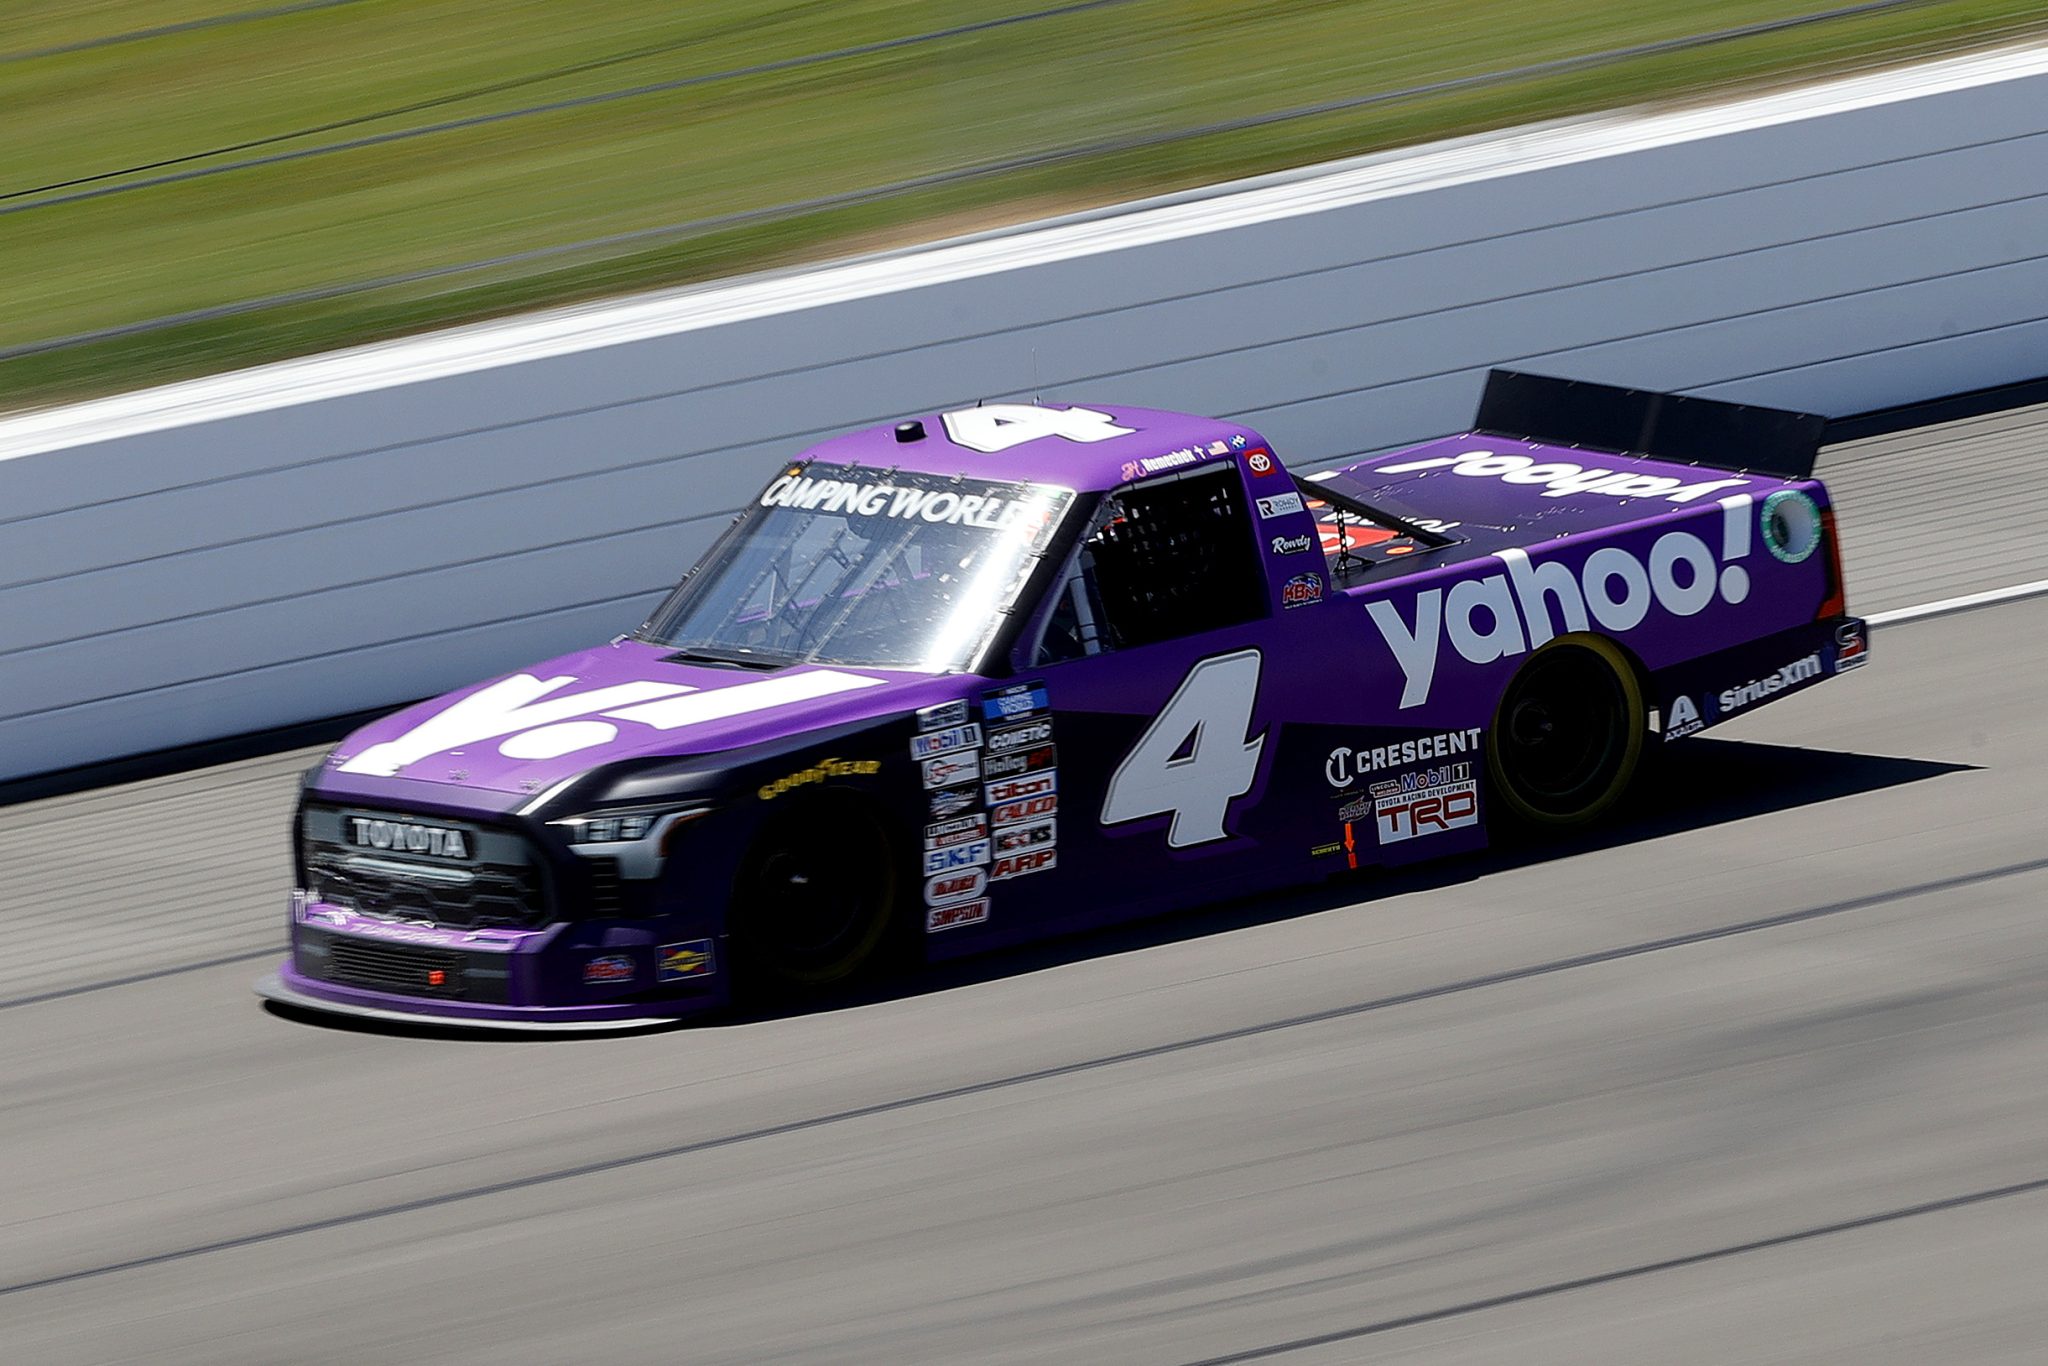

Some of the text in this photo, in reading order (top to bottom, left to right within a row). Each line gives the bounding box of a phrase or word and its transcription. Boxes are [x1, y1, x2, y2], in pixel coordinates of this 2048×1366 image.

[941, 404, 1136, 453] 4
[1140, 448, 1197, 472] Nemechek
[1375, 450, 1751, 503] yahoo!
[760, 475, 896, 517] CAMPING
[1272, 534, 1311, 554] Rowdy
[1282, 581, 1321, 604] KBM
[1365, 494, 1753, 710] yahoo!
[1100, 649, 1266, 848] 4
[1356, 727, 1481, 774] CRESCENT
[1377, 782, 1474, 808] TOYOTA RACING DEVELOPMENT
[1401, 766, 1450, 792] Mobil
[1378, 791, 1476, 836] TRD
[352, 818, 467, 858] TOYOTA
[926, 842, 987, 872] SKF
[991, 849, 1055, 878] ARP
